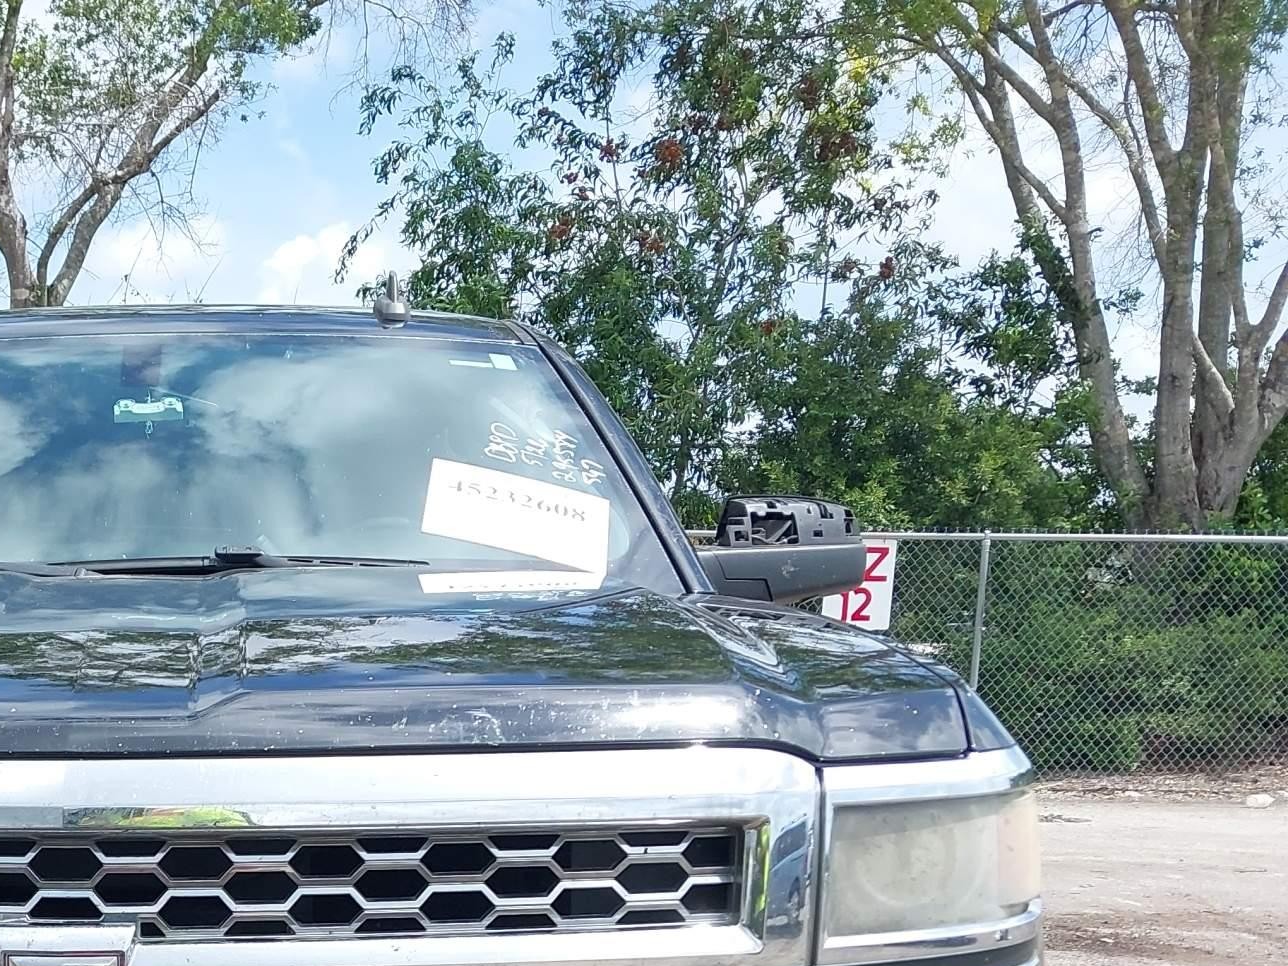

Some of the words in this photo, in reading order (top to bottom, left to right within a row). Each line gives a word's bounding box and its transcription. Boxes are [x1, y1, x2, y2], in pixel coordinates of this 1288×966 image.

[448, 480, 585, 521] 45232608
[863, 546, 889, 582] Z
[840, 587, 872, 623] 12
